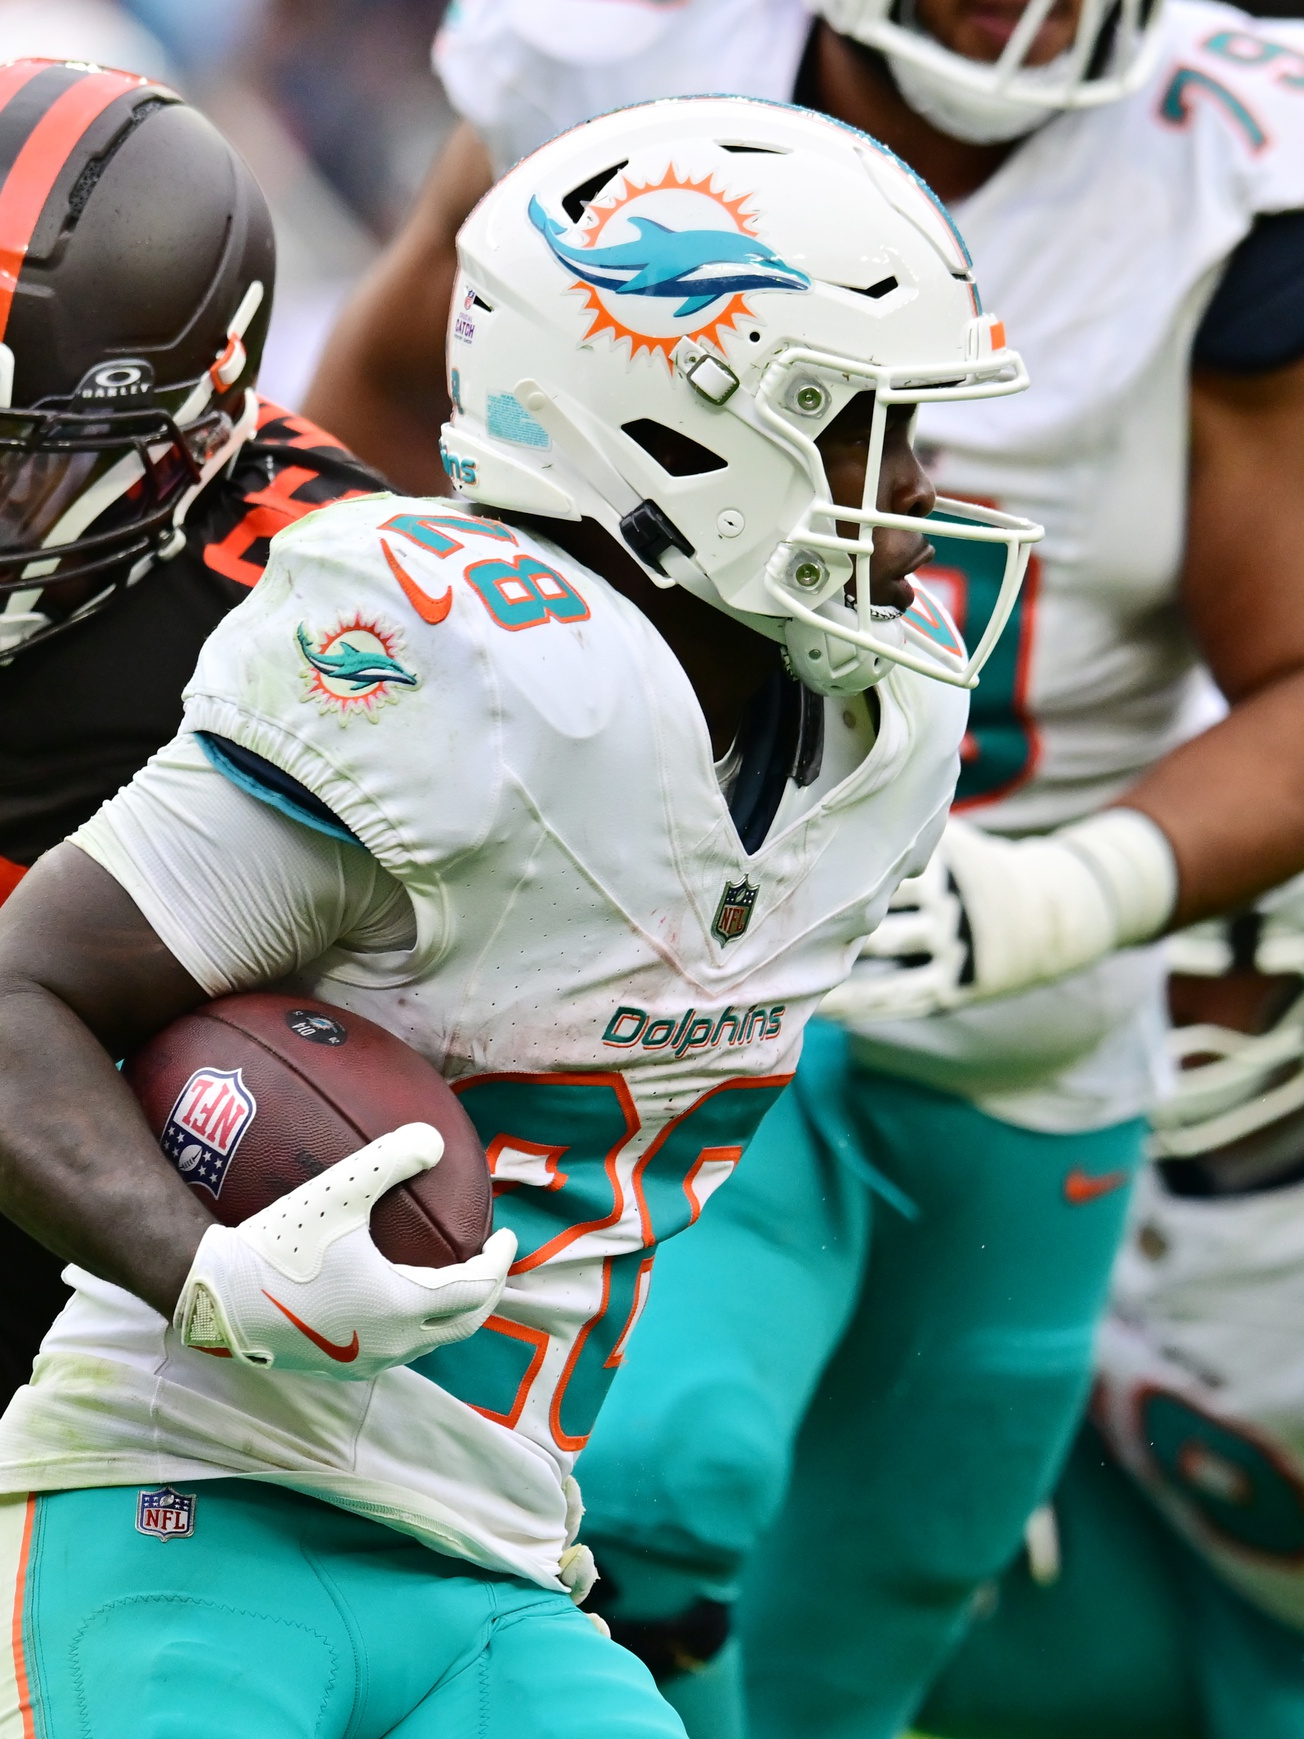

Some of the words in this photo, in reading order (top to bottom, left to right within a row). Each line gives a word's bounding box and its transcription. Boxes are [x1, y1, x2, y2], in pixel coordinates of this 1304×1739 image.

[82, 383, 153, 398] OAKLEY
[377, 513, 591, 631] 28
[719, 907, 745, 935] NFL
[601, 1005, 786, 1059] Dolphins
[182, 1079, 245, 1151] NFL
[145, 1509, 185, 1531] NFL
